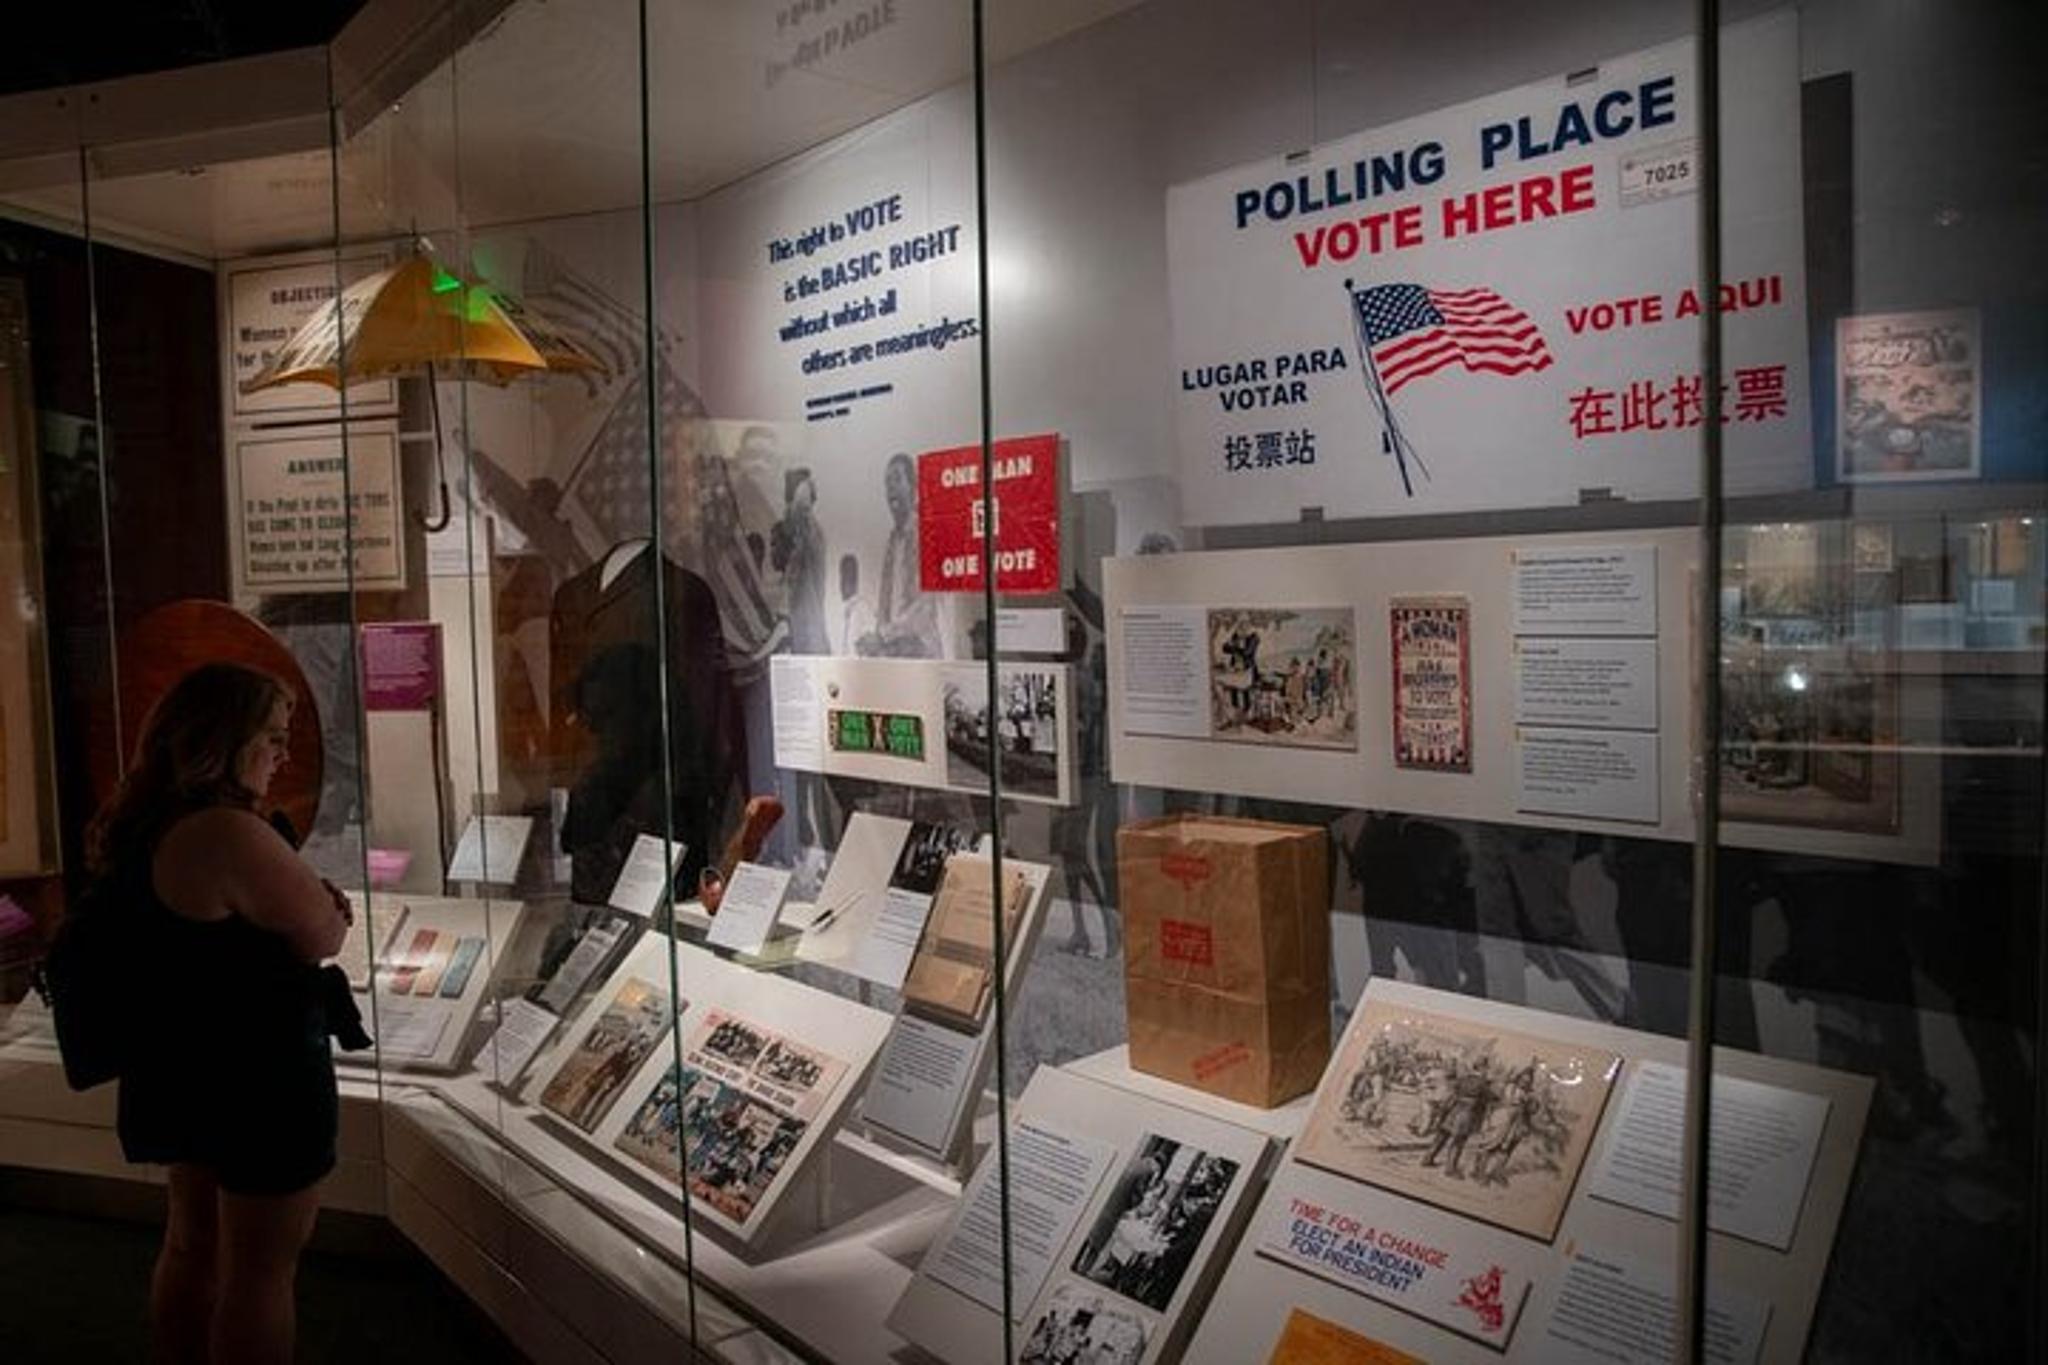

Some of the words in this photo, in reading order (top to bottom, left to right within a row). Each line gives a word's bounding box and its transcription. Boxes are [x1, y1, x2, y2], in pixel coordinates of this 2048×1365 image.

[1236, 142, 1445, 229] POLLING
[1481, 76, 1675, 170] PLACE
[1644, 161, 1689, 185] 7025
[768, 237, 794, 263] This
[796, 226, 826, 257] right
[829, 221, 844, 242] to
[845, 194, 902, 236] VOTE
[1295, 205, 1424, 269] VOTE
[1443, 165, 1596, 238] HERE
[784, 282, 797, 303] is
[798, 275, 820, 298] the
[822, 251, 882, 291] BASIC
[889, 224, 961, 270] RIGHT
[271, 286, 342, 304] OBJECTIO
[779, 311, 830, 342] without
[833, 296, 876, 328] which
[878, 289, 897, 316] all
[1566, 296, 1662, 334] VOTE
[1675, 275, 1782, 319] AQUI
[802, 349, 847, 375] others
[849, 344, 874, 365] are
[1182, 360, 1267, 391] LUGAR
[1276, 347, 1347, 378] PARA
[1220, 381, 1308, 412] VOTAR
[1569, 365, 1787, 439] 在此投票
[941, 464, 979, 488] ONE
[1225, 428, 1316, 472] 投票站
[942, 553, 979, 578] ONE
[1290, 1199, 1326, 1224] TIME
[1328, 1212, 1361, 1237] FOR
[1364, 1227, 1375, 1245] A
[1378, 1232, 1449, 1270] CHANGE
[1291, 1219, 1341, 1247] ELECT
[1342, 1239, 1365, 1257] AN
[1368, 1250, 1426, 1280] INDIAN
[1289, 1235, 1322, 1257] FOR
[1323, 1248, 1412, 1293] PRESIDENT
